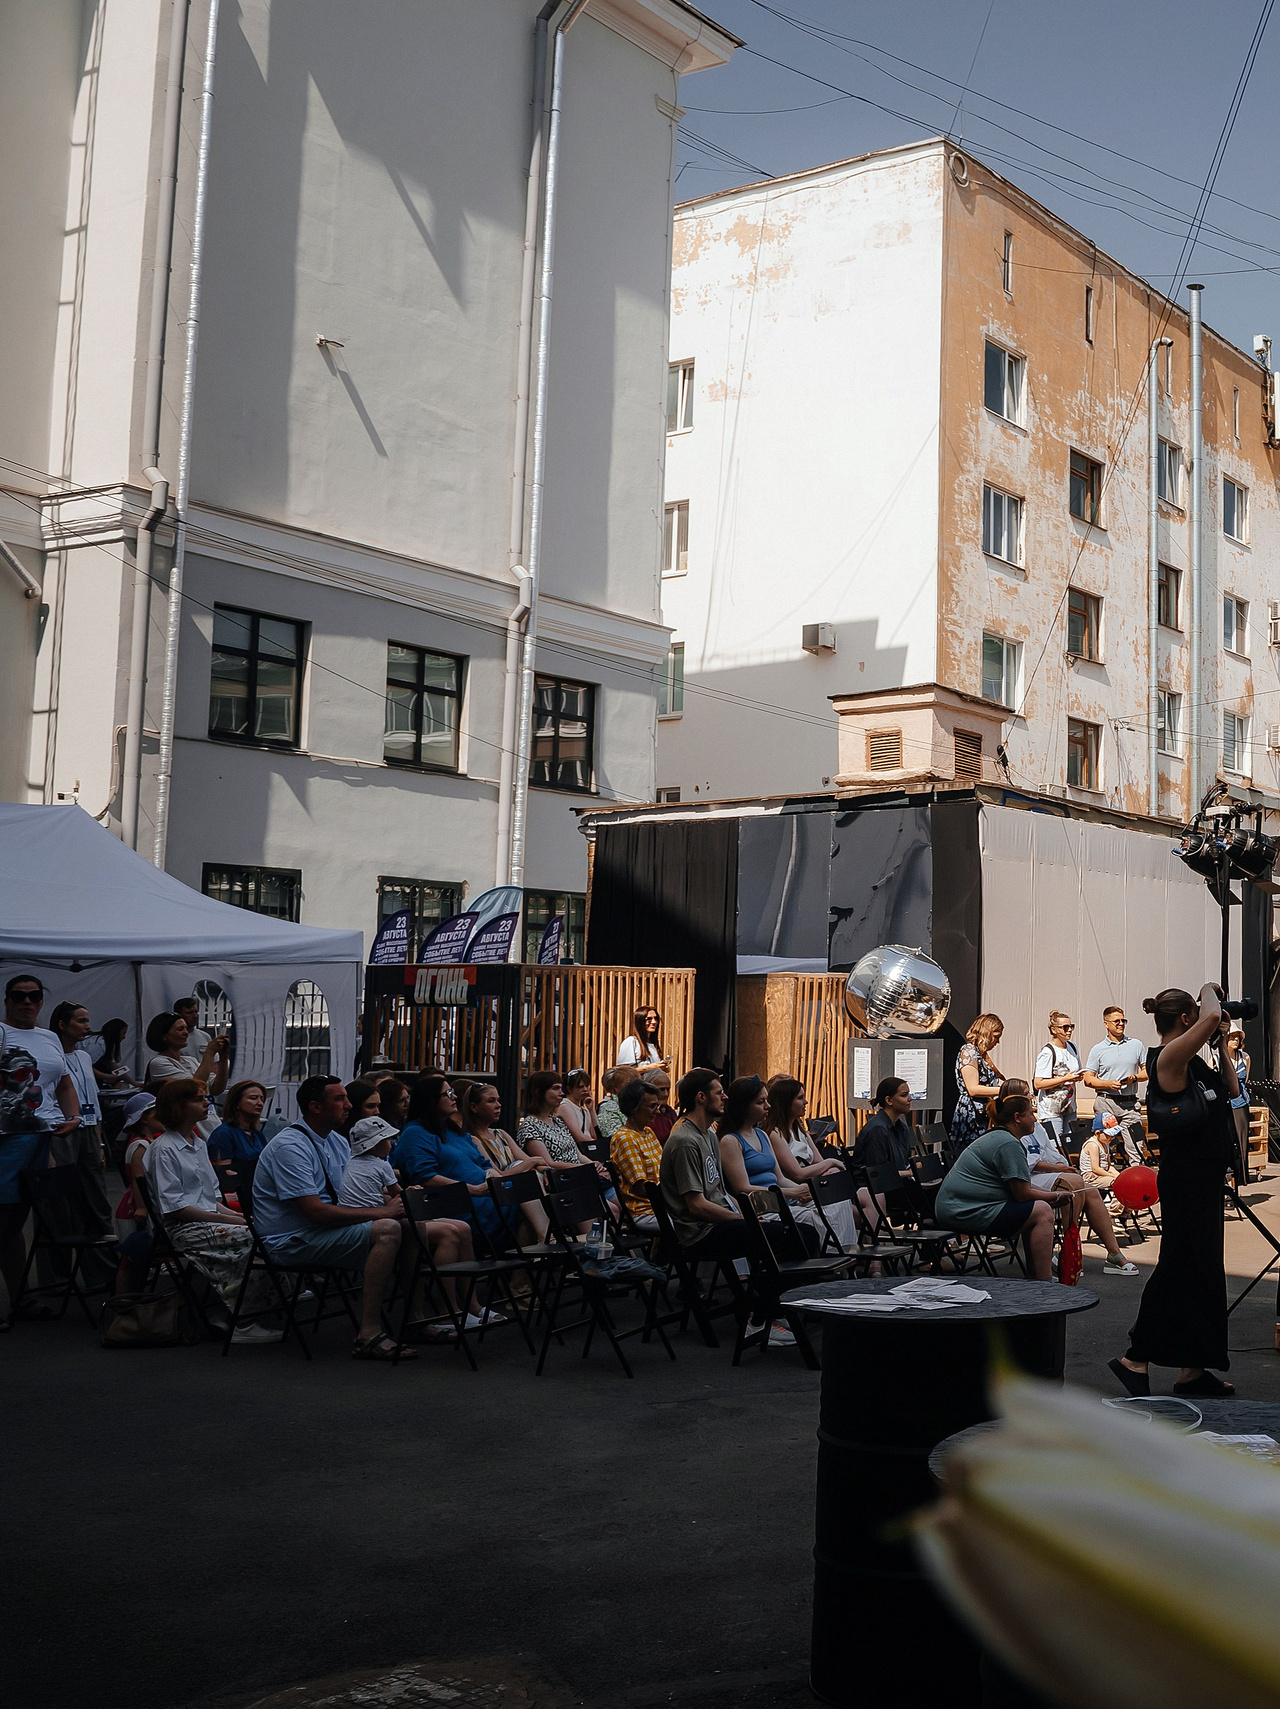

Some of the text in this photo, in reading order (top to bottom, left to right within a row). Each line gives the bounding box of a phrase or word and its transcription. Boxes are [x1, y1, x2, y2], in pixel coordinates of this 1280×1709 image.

[396, 916, 407, 929] 23
[454, 918, 471, 931] 23
[498, 920, 512, 932] 23
[382, 928, 407, 940] АВГУСТА
[435, 930, 467, 943] АВГУСТА
[480, 931, 510, 943] АВГУСТА
[423, 948, 451, 959] СОБЫТИЕ
[471, 949, 496, 959] СОБЫТИЕ
[414, 968, 469, 1005] ОГОНЬ
